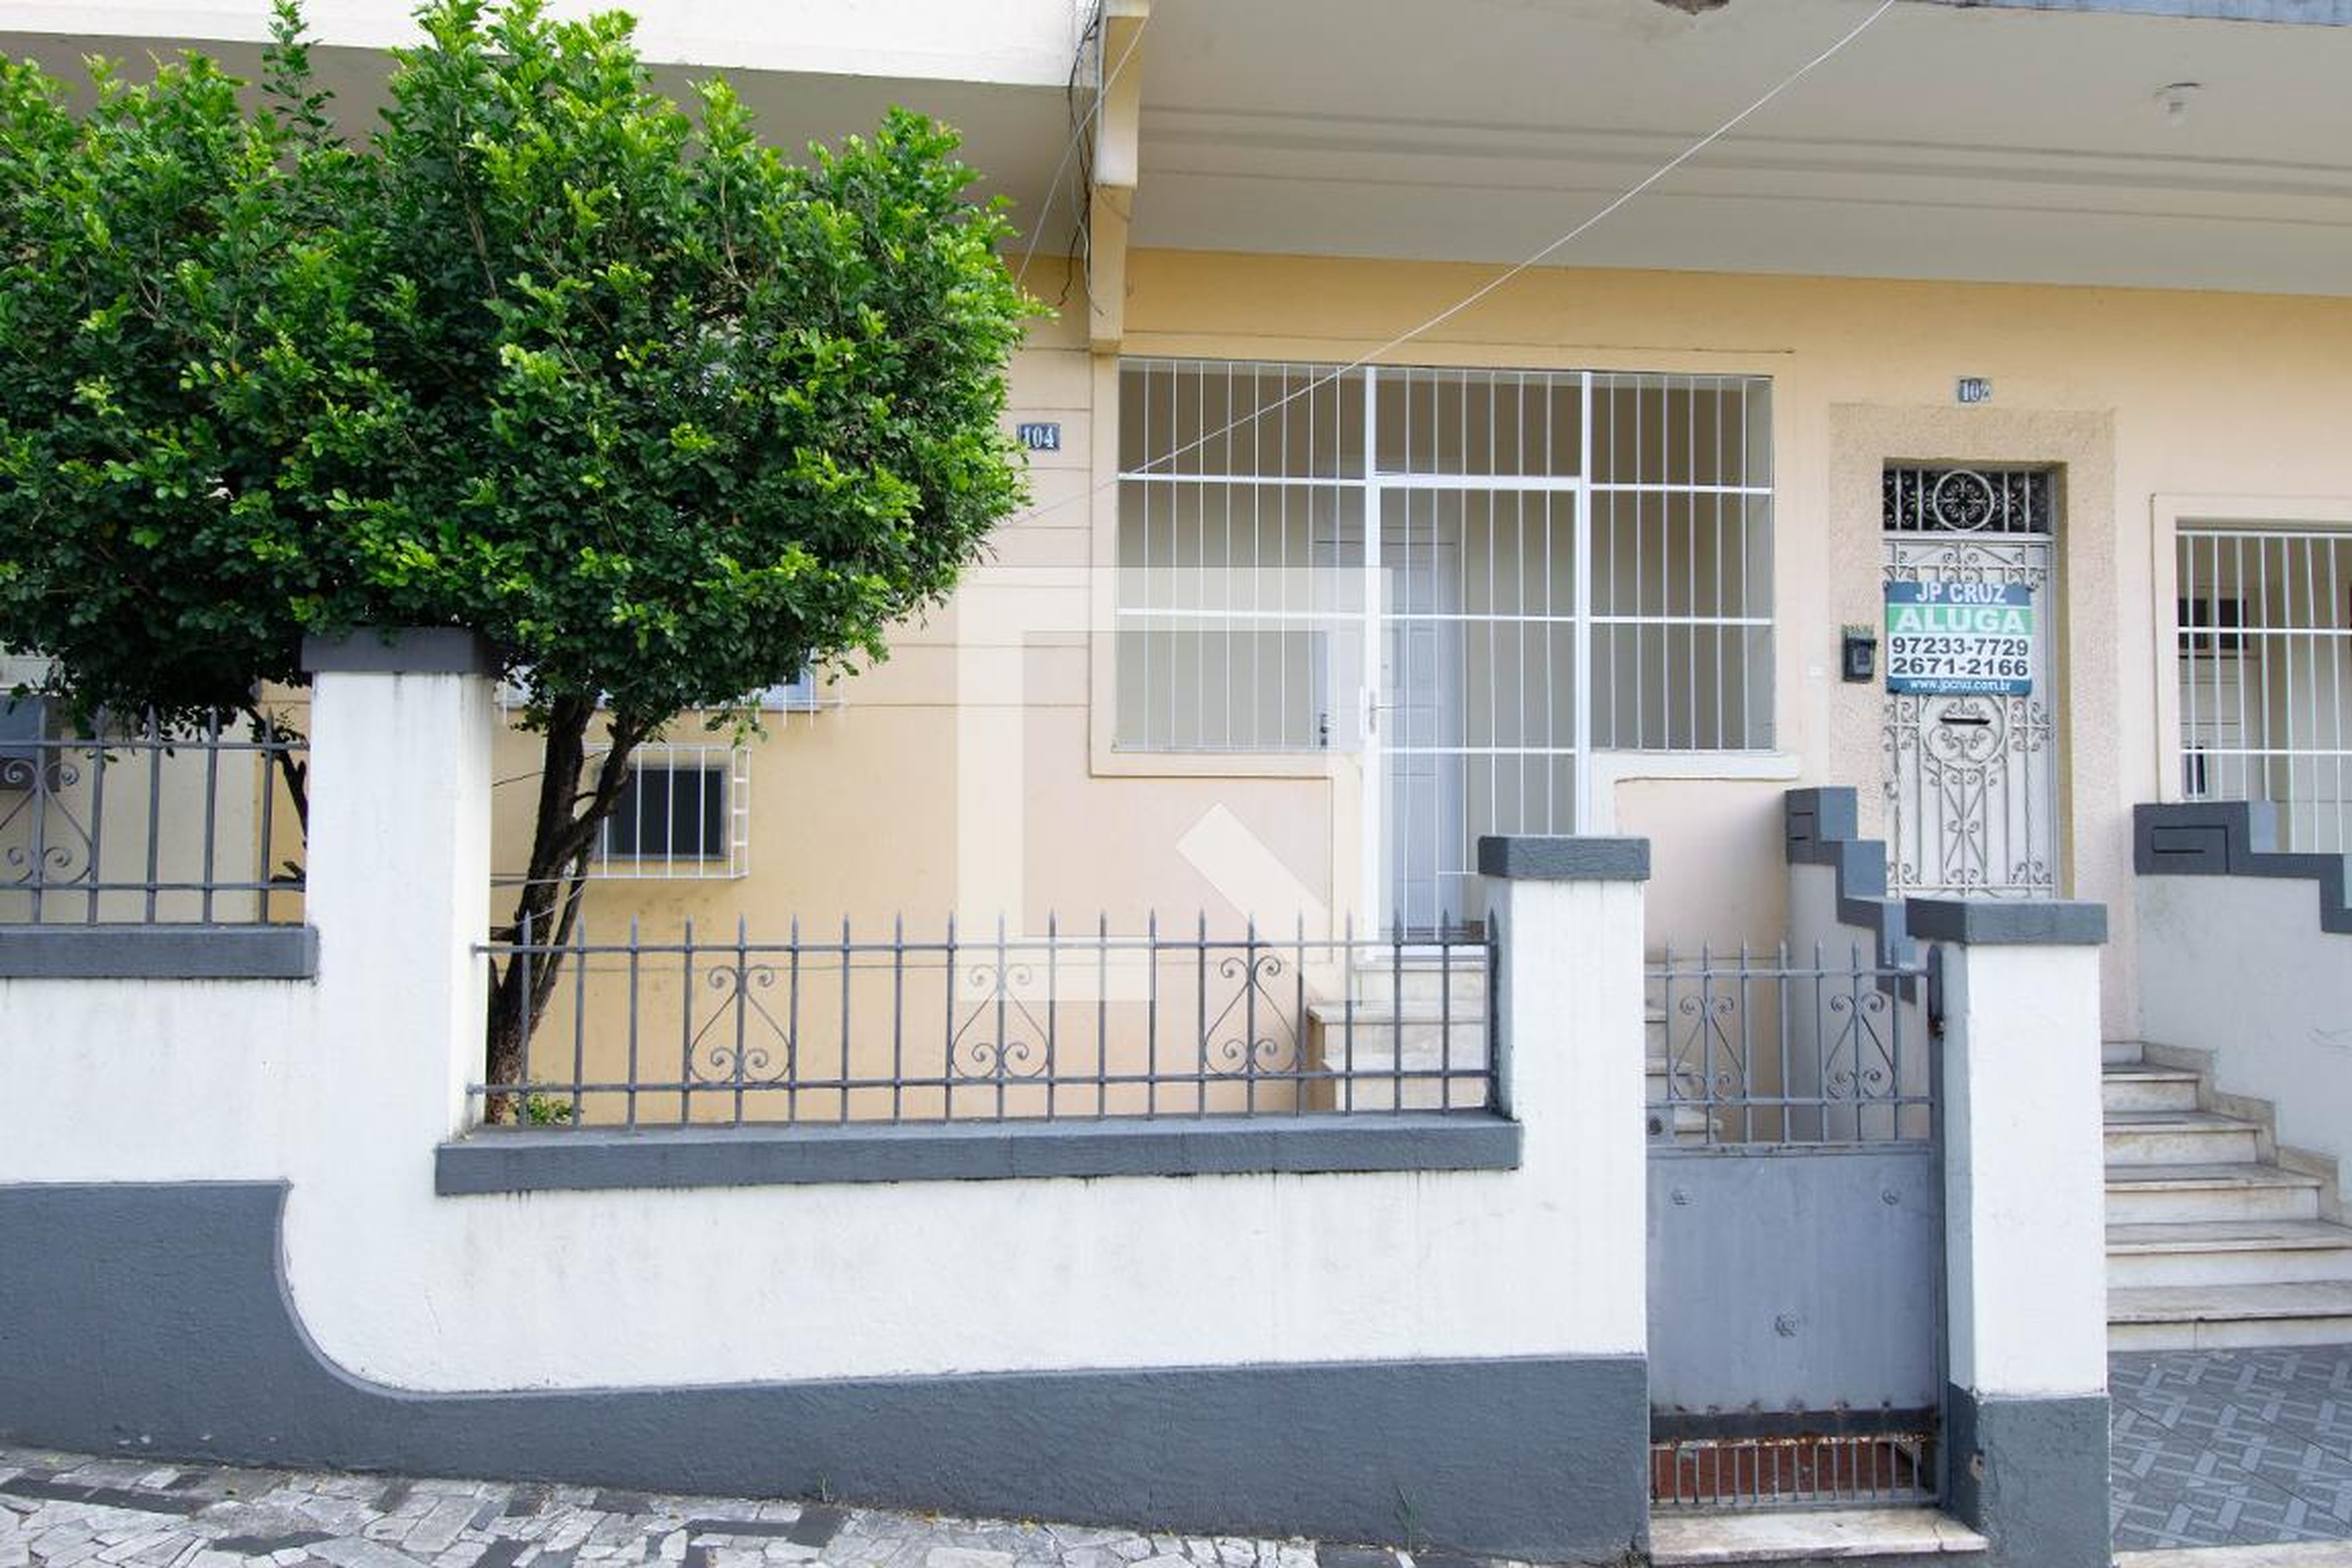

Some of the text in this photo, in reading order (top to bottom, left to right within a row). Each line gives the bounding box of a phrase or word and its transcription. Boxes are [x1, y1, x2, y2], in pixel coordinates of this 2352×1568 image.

[1023, 426, 1054, 448] 104
[1915, 582, 2007, 603] JP CRUZ
[1894, 608, 2026, 633] ALUGA
[1892, 637, 2029, 656] 97233-7729
[1892, 657, 2028, 676] 2671-2166
